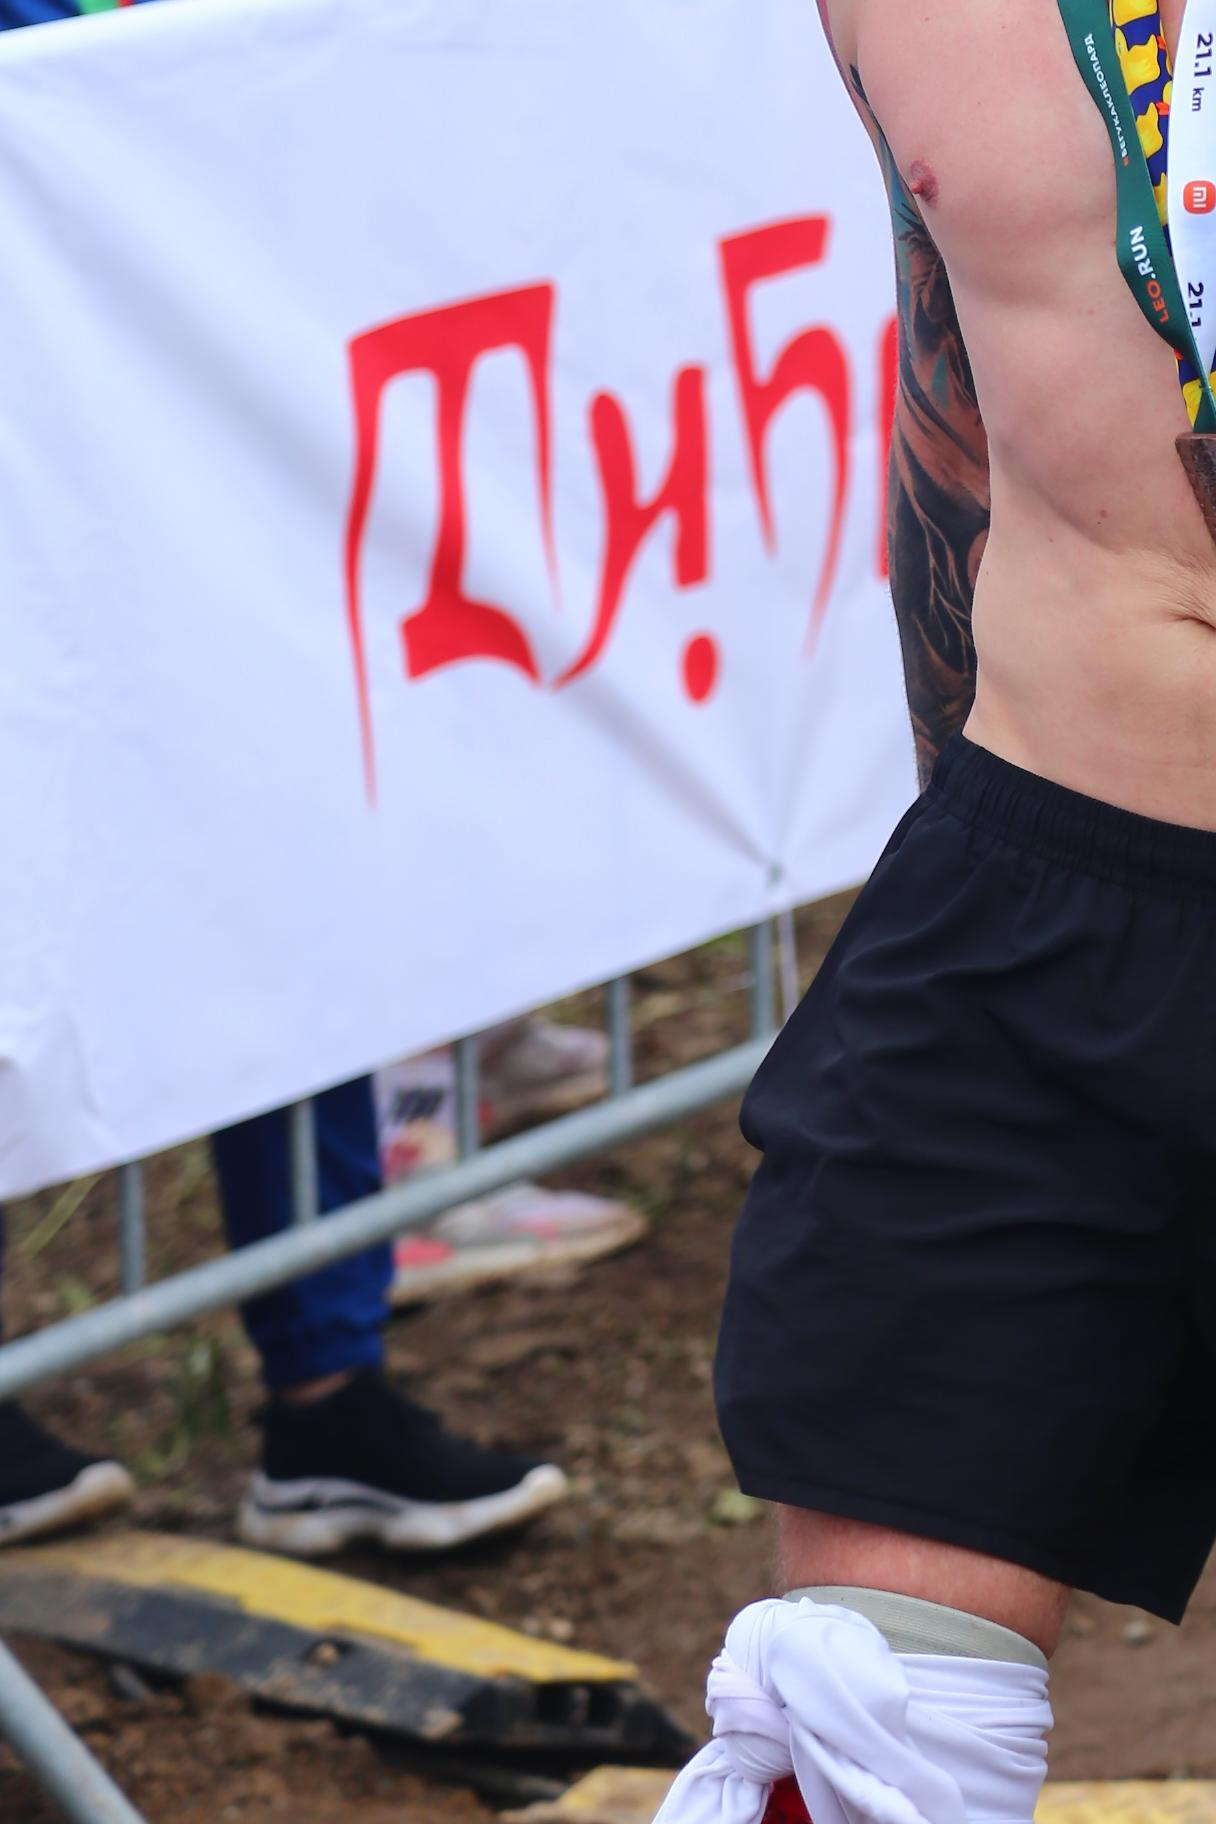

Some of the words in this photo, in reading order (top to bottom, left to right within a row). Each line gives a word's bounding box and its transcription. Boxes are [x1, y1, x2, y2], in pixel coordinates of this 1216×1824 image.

[1195, 32, 1214, 79] 21.1
[1191, 86, 1205, 113] km
[1130, 225, 1170, 325] LEO.RUN
[1187, 281, 1205, 329] 21.1
